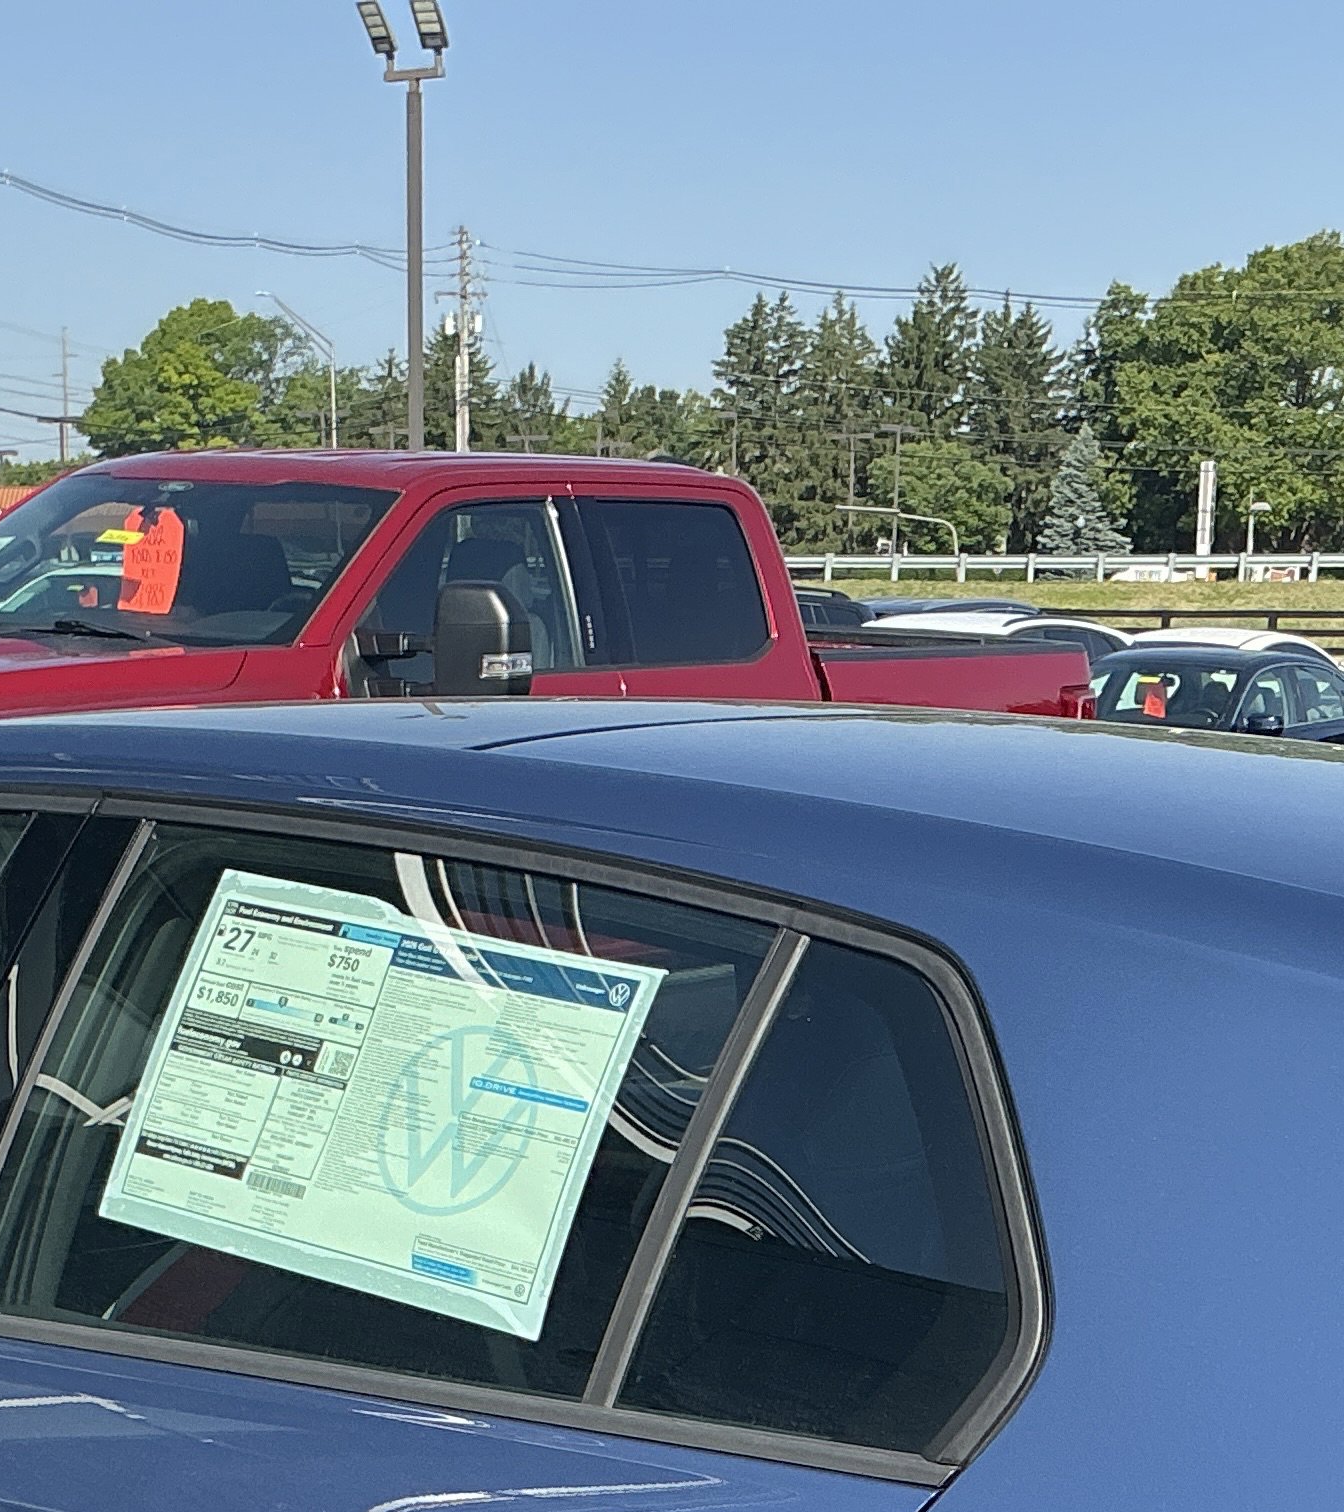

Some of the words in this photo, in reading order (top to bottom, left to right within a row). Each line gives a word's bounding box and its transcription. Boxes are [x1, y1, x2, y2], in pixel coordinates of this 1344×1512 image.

[223, 927, 256, 953] 27
[344, 945, 373, 958] spend
[327, 954, 360, 972] $750
[225, 981, 244, 991] cost
[197, 987, 239, 1007] $1,850
